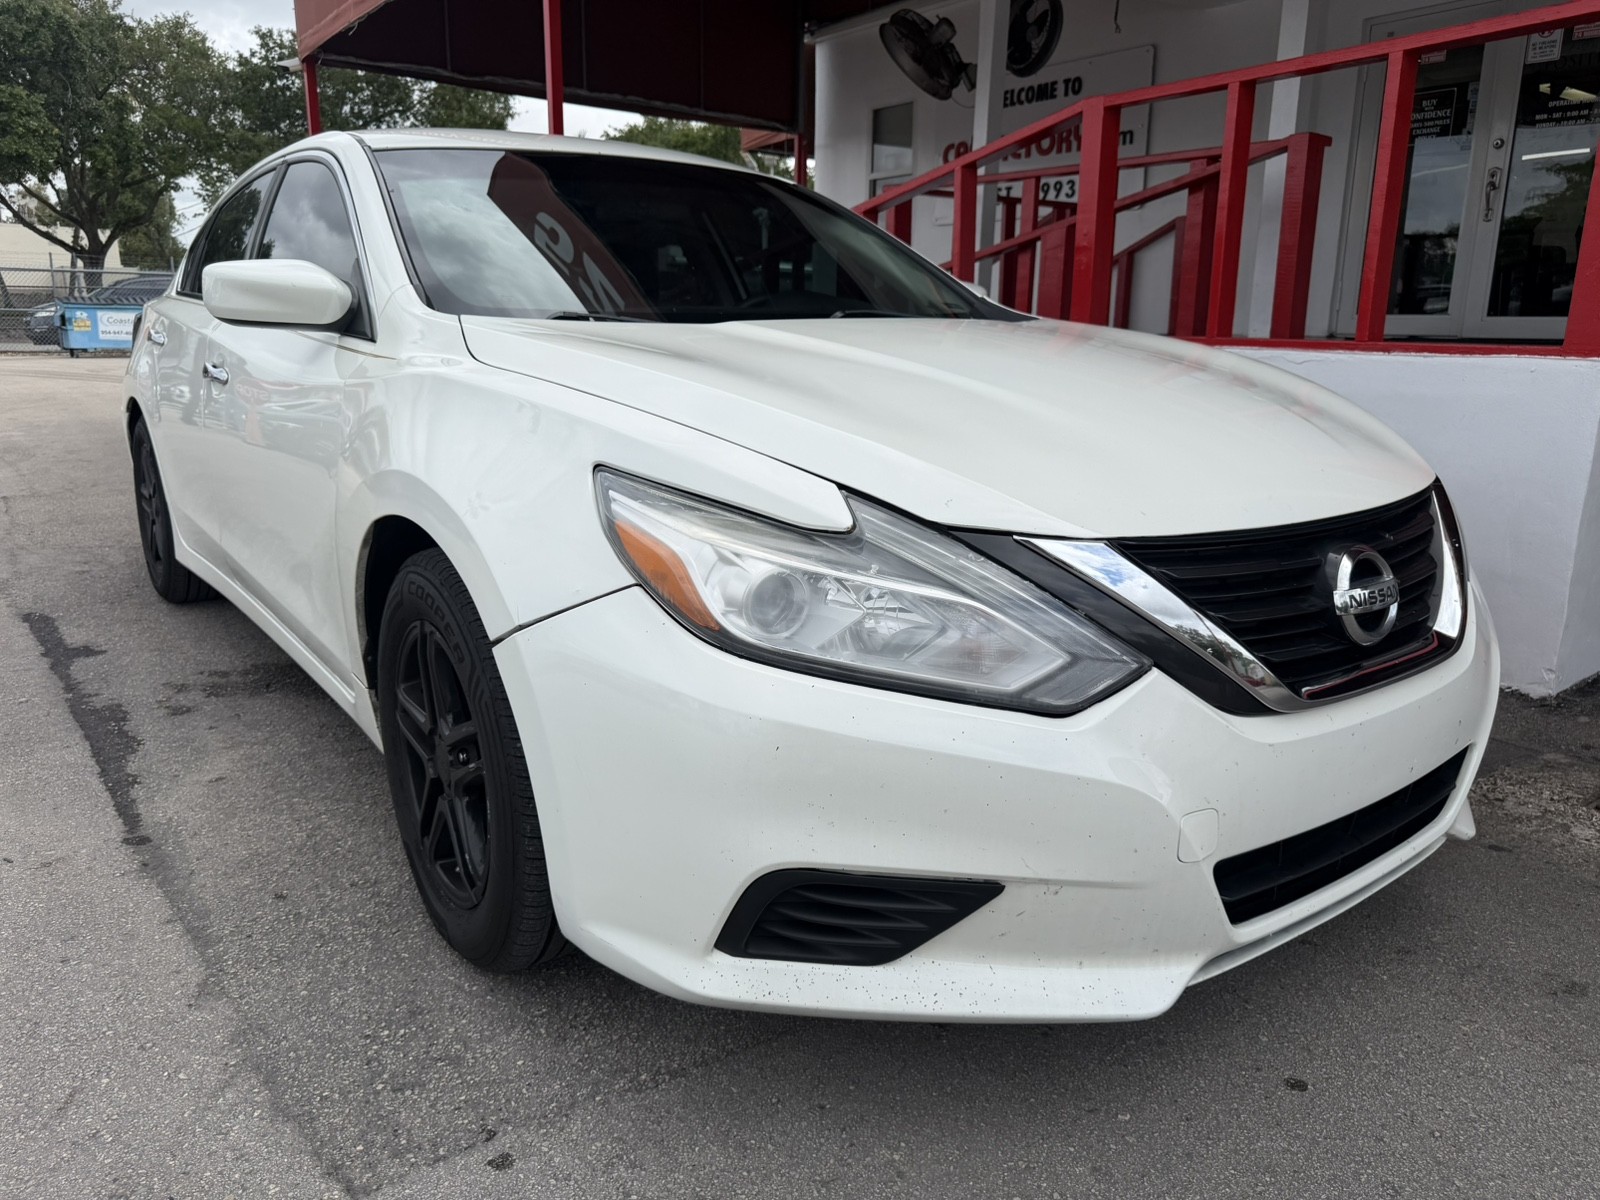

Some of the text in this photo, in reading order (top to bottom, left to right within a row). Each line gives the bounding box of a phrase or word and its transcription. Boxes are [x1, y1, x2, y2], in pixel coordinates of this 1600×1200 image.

[1003, 76, 1083, 108] ELCOME TO
[1422, 98, 1438, 107] BUY
[1411, 108, 1451, 121] ONFIDENCE
[1040, 179, 1076, 201] 993
[1348, 584, 1398, 609] NISSAN
[408, 581, 465, 664] COOPER
